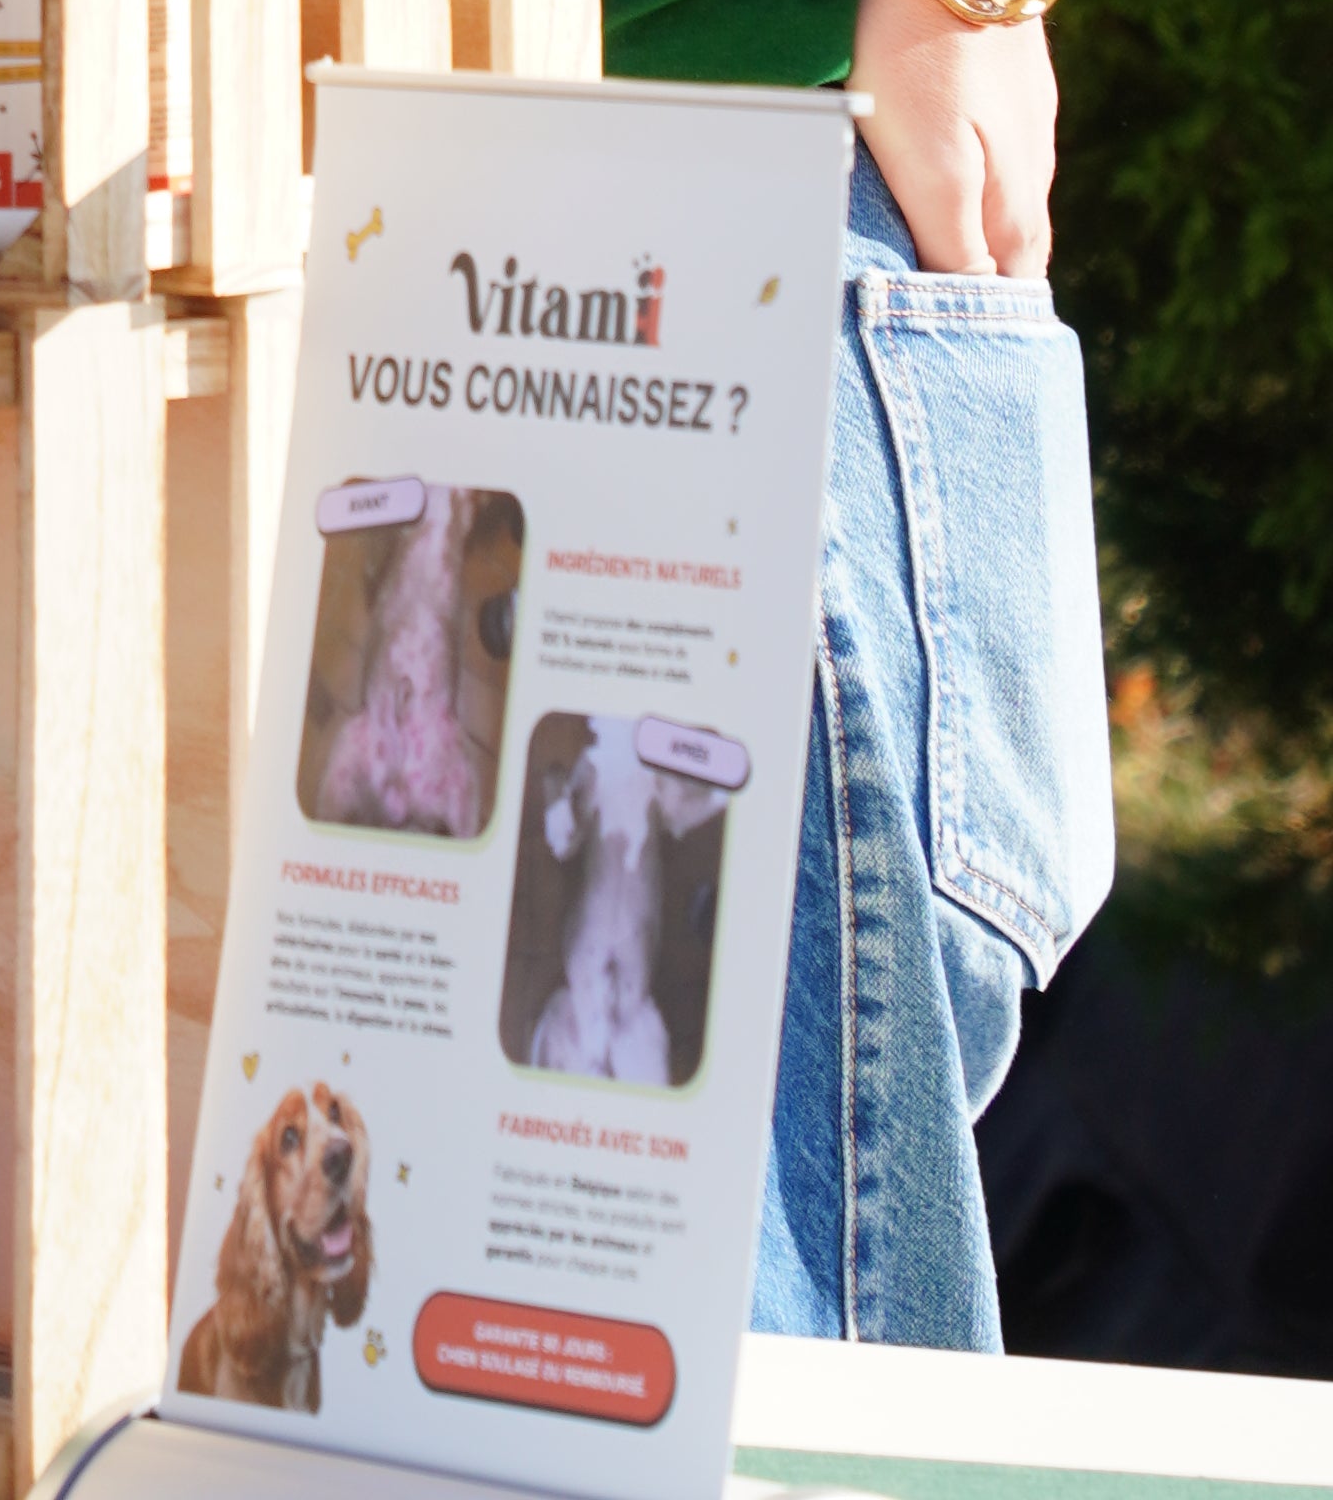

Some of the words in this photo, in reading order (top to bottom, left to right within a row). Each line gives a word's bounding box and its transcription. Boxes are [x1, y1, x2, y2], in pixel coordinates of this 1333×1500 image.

[348, 353, 453, 412] VOUS
[465, 364, 716, 432] CONNAISSEZ
[728, 385, 750, 435] ?
[547, 547, 651, 581] INGRÉDIENTS
[657, 560, 742, 590] NATURELS
[281, 861, 366, 892] FORMULES
[372, 870, 460, 905] EFFICACES
[499, 1113, 592, 1148] FABRIQUÉS
[598, 1127, 644, 1156] AVEC
[649, 1133, 689, 1162] SOIN
